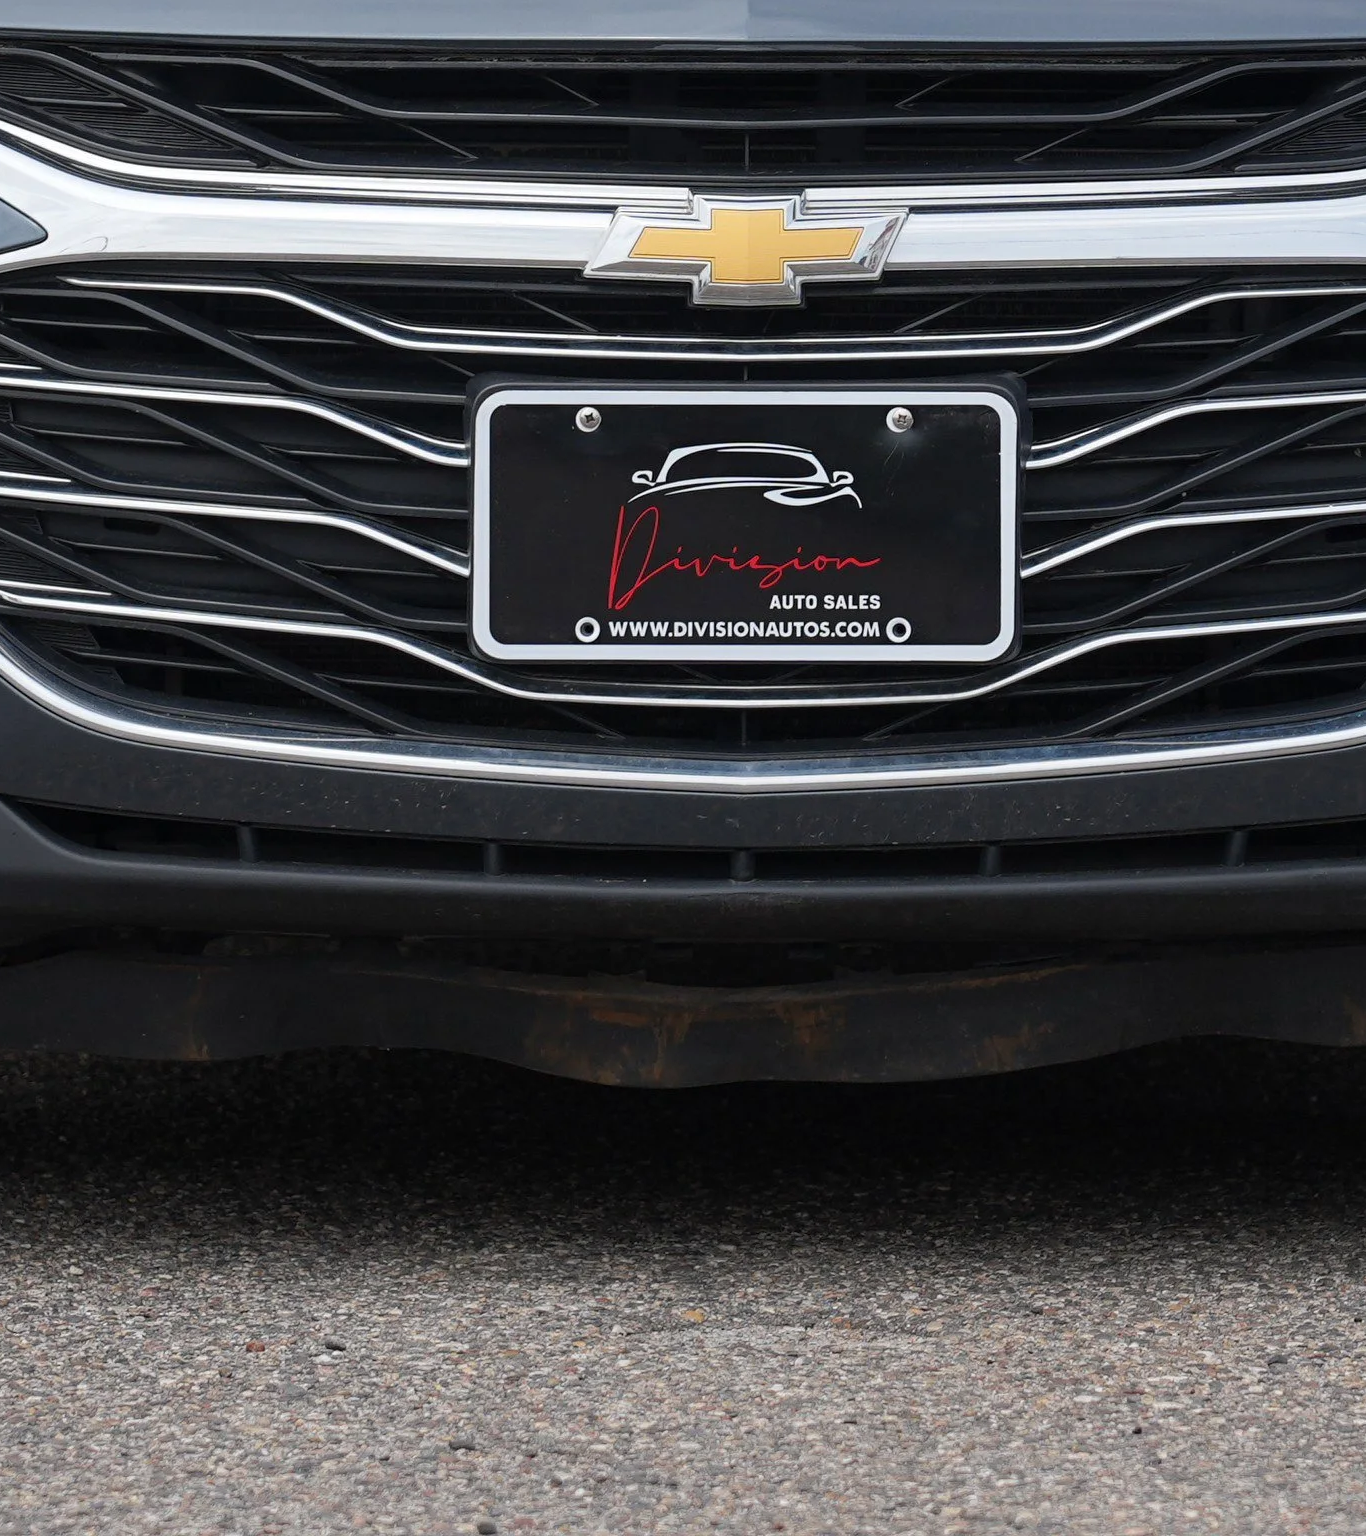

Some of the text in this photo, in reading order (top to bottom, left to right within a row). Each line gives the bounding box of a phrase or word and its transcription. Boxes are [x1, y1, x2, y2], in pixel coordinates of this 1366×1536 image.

[608, 506, 881, 609] Division
[769, 595, 881, 610] AUTO SALES
[608, 621, 881, 638] WWW.DIVISIONAUTOS.COM
